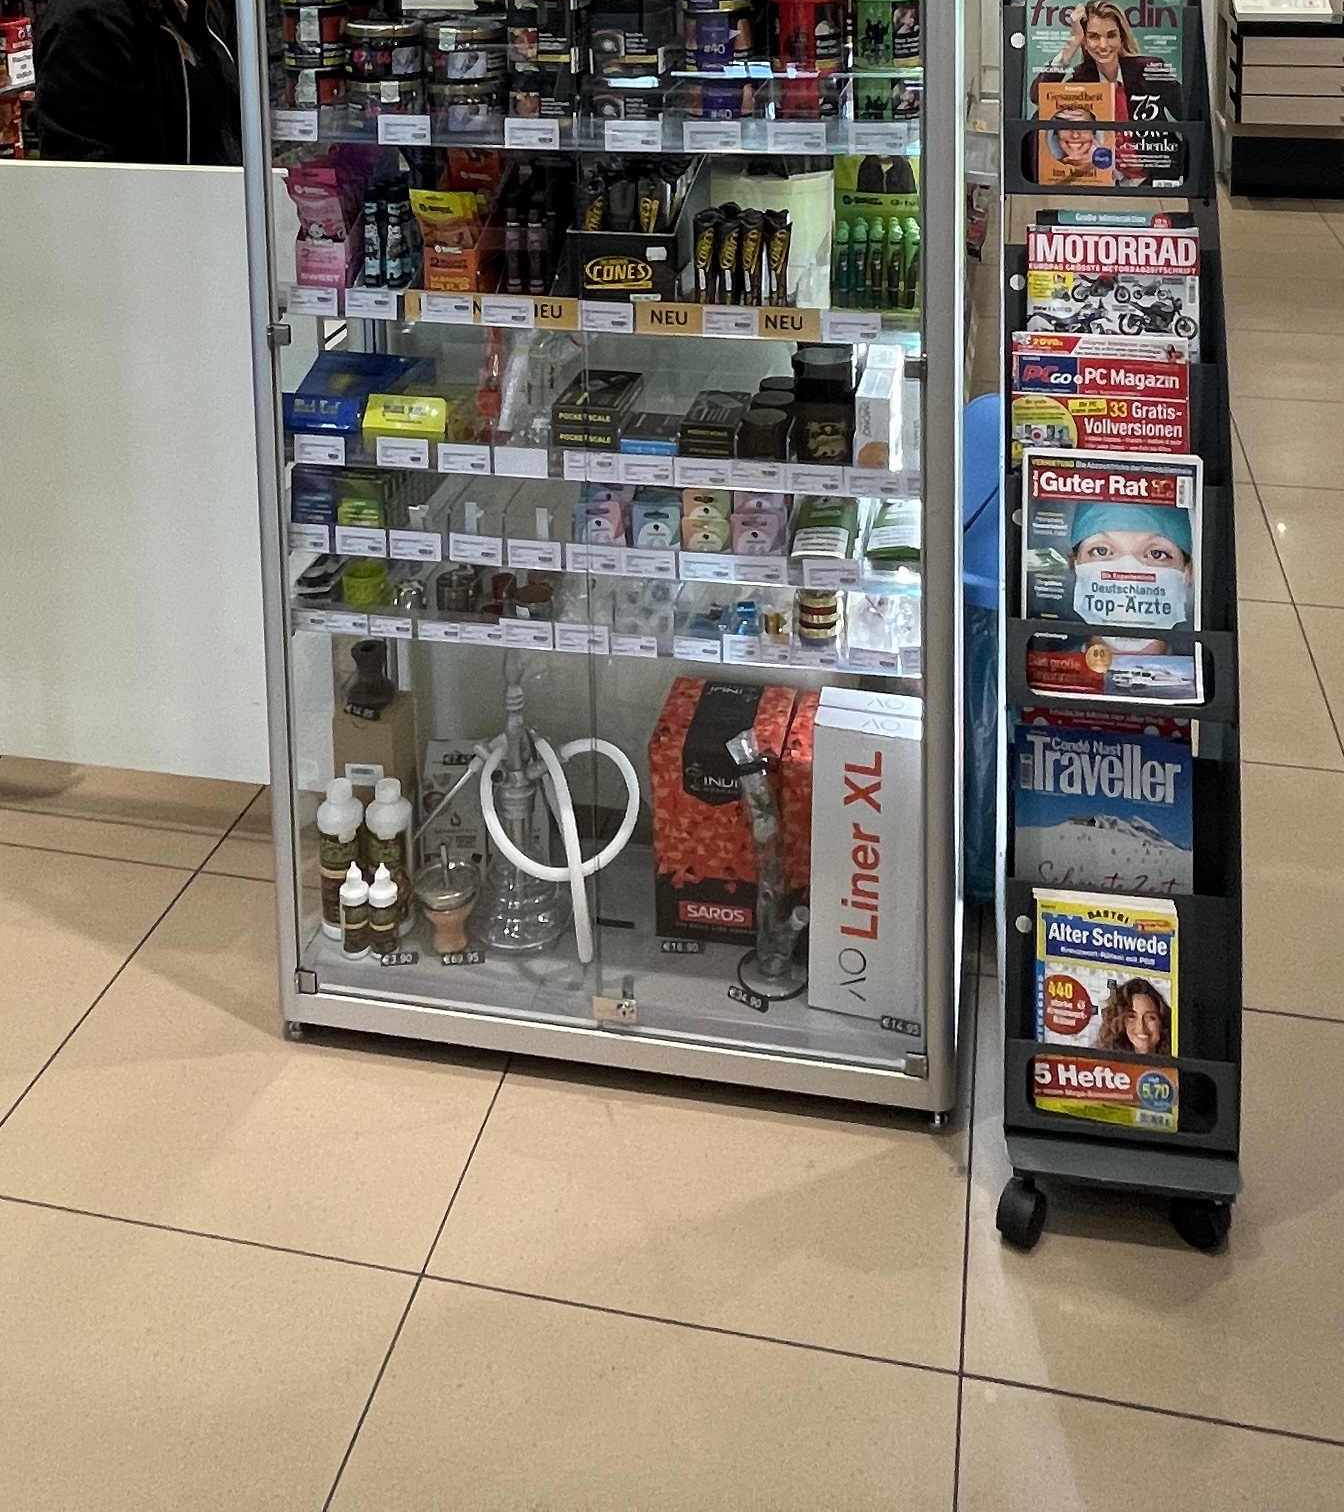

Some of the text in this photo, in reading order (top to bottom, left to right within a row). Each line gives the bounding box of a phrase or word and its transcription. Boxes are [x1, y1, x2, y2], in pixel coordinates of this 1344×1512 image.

[1046, 90, 1104, 102] Gesundheit
[1129, 93, 1161, 121] 75
[1114, 138, 1180, 152] Geschenke
[1035, 233, 1198, 267] MOTORRAD
[592, 264, 647, 283] CONES
[1102, 265, 1197, 275] MOTORRADZEITSCHRIFT
[650, 309, 688, 325] NEU
[765, 315, 803, 331] NEU
[1084, 367, 1107, 386] PC
[1110, 369, 1180, 390] Magazin
[558, 411, 586, 423] POCKET
[1109, 401, 1183, 420] 33 Gratis-
[1084, 417, 1184, 438] Vollversionen
[559, 432, 612, 445] POCKET SCALE
[1040, 471, 1149, 497] Guter Rat
[1091, 582, 1167, 597] Deutschlands
[1084, 594, 1172, 617] Top-Ärzte
[1051, 736, 1122, 757] Condé Nast
[1026, 734, 1182, 804] Traveller
[839, 750, 883, 941] Liner XL
[686, 904, 746, 922] SAROS
[1087, 909, 1130, 924] BASTEI
[1048, 922, 1169, 956] Alter Schwede
[1048, 981, 1074, 999] 440
[1034, 1061, 1131, 1090] 5 Hefte
